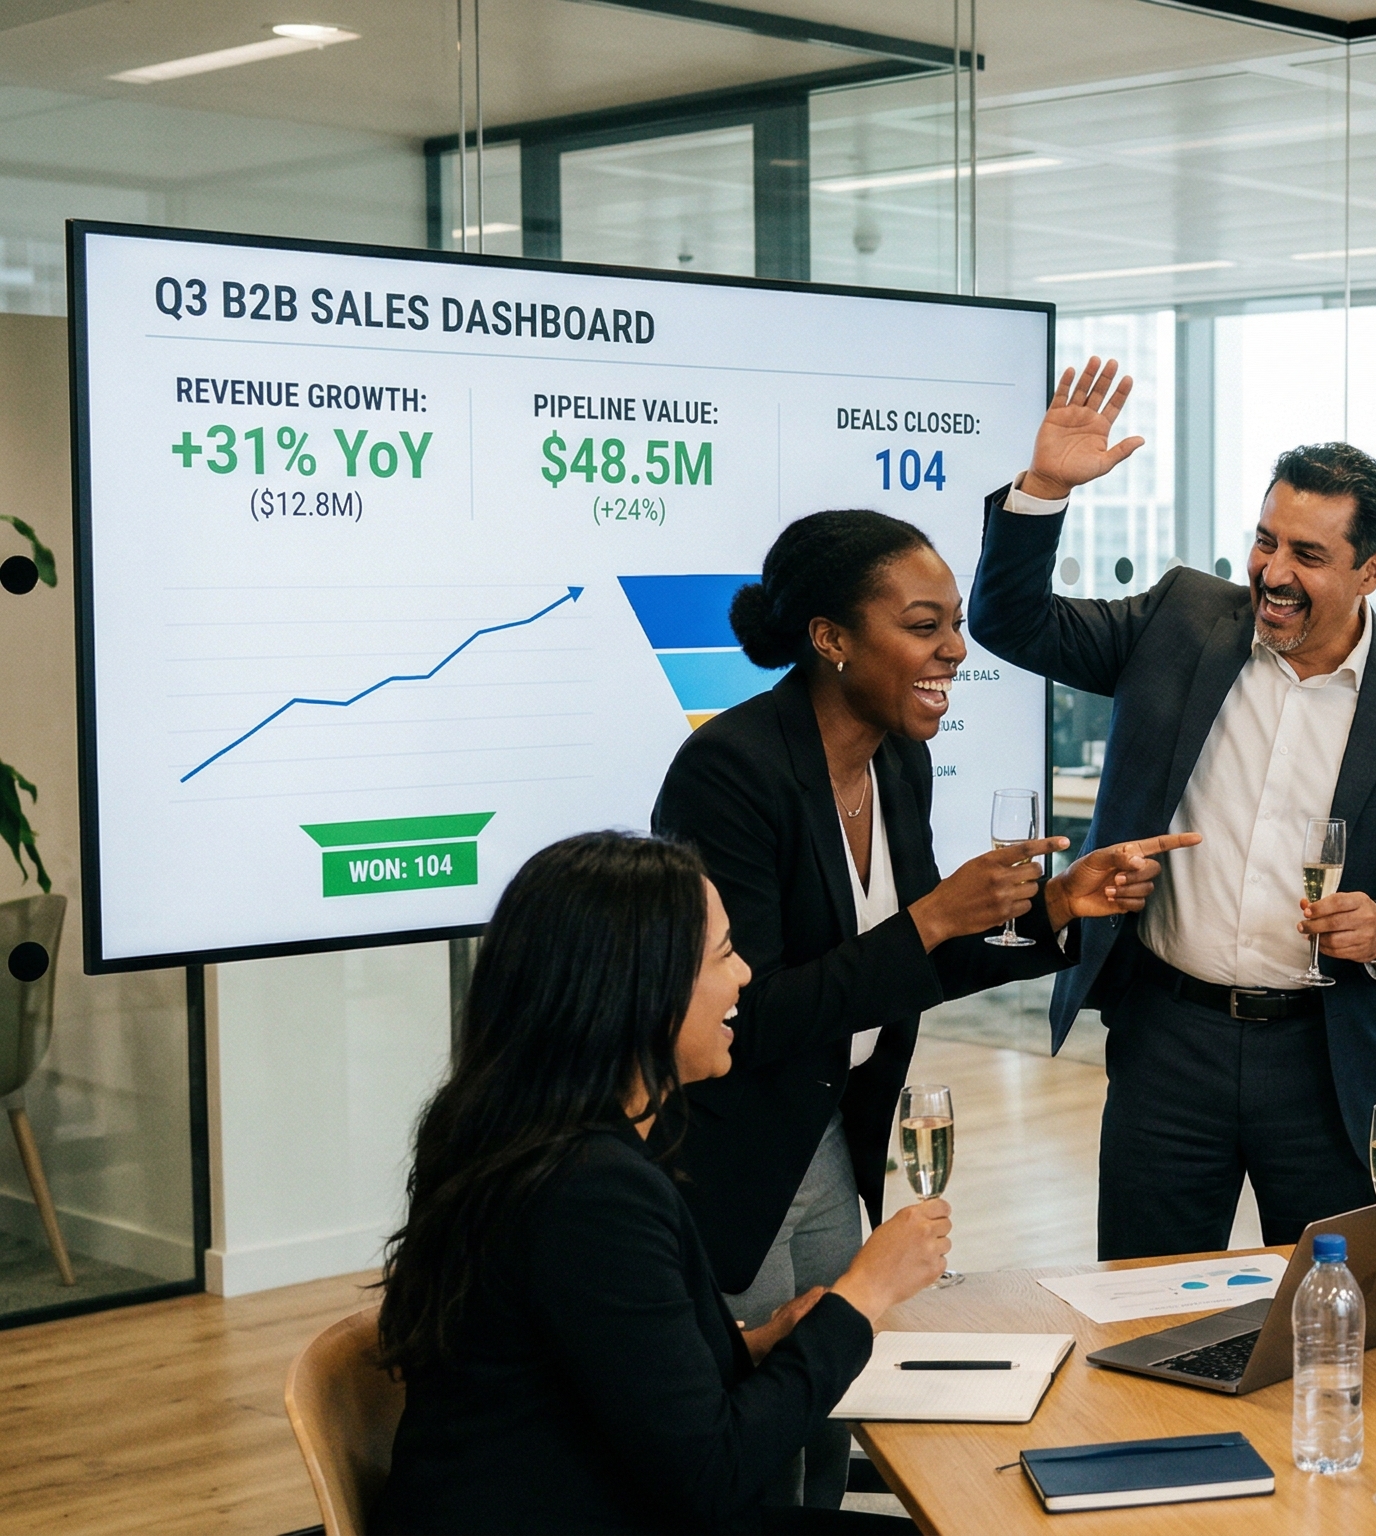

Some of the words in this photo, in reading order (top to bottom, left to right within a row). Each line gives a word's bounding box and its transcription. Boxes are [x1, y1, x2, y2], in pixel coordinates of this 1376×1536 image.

[156, 277, 207, 320] Q3
[223, 281, 297, 322] B2B
[311, 288, 429, 330] SALES
[442, 297, 654, 344] DASHBOARD
[177, 377, 299, 407] REVENUE
[308, 384, 426, 412] GROWTH:
[534, 394, 635, 421] PIPELINE
[643, 399, 718, 424] VALUE:
[837, 408, 898, 431] DEALS
[904, 411, 980, 434] CLOSED:
[172, 425, 316, 476] +31%
[334, 429, 433, 478] YoY
[541, 430, 712, 488] $48.5M
[876, 449, 946, 491] 104
[251, 488, 362, 522] ($12.8M)
[594, 496, 665, 526] (+24%)
[349, 858, 407, 882] WON:
[415, 854, 452, 877] 104
